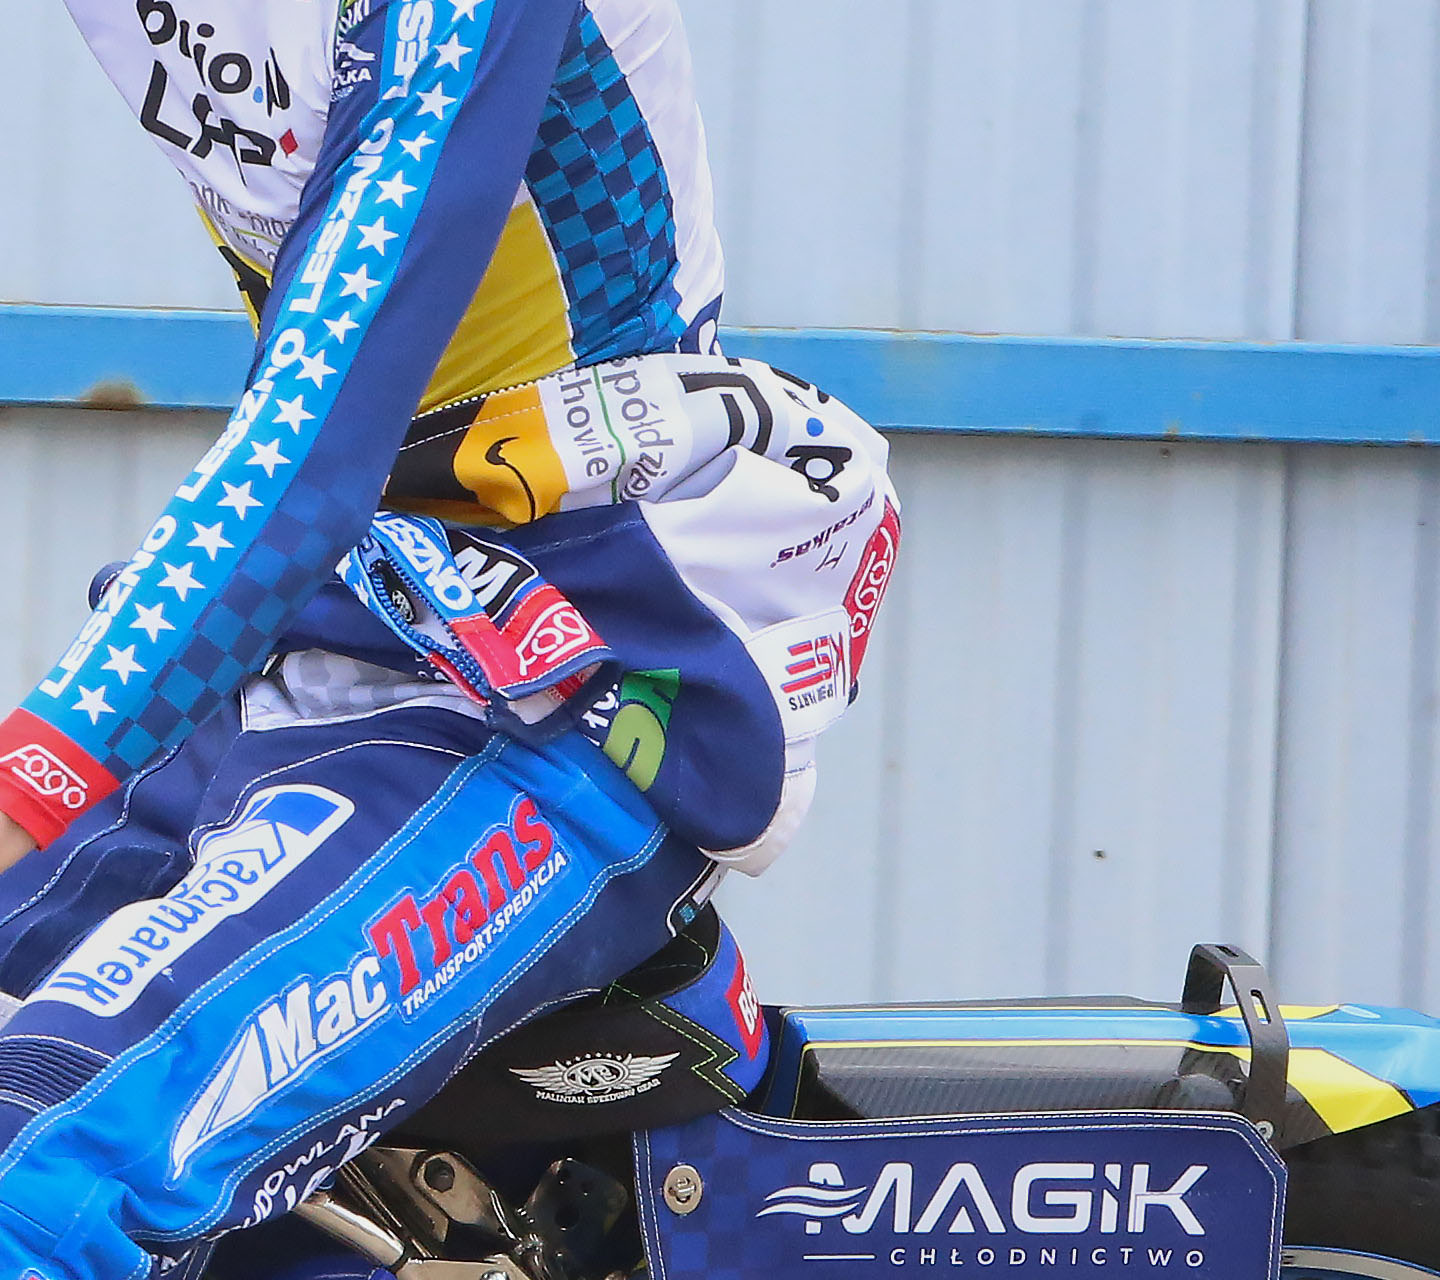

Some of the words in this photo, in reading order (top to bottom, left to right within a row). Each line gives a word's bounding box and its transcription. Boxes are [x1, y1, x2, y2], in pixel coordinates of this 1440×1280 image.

[38, 514, 178, 700] LESZNO
[403, 851, 568, 1015] TRANSPORT-SPEDYCJA
[806, 1163, 1210, 1237] MAGIK
[889, 1247, 1206, 1268] CHŁODNICTWO
